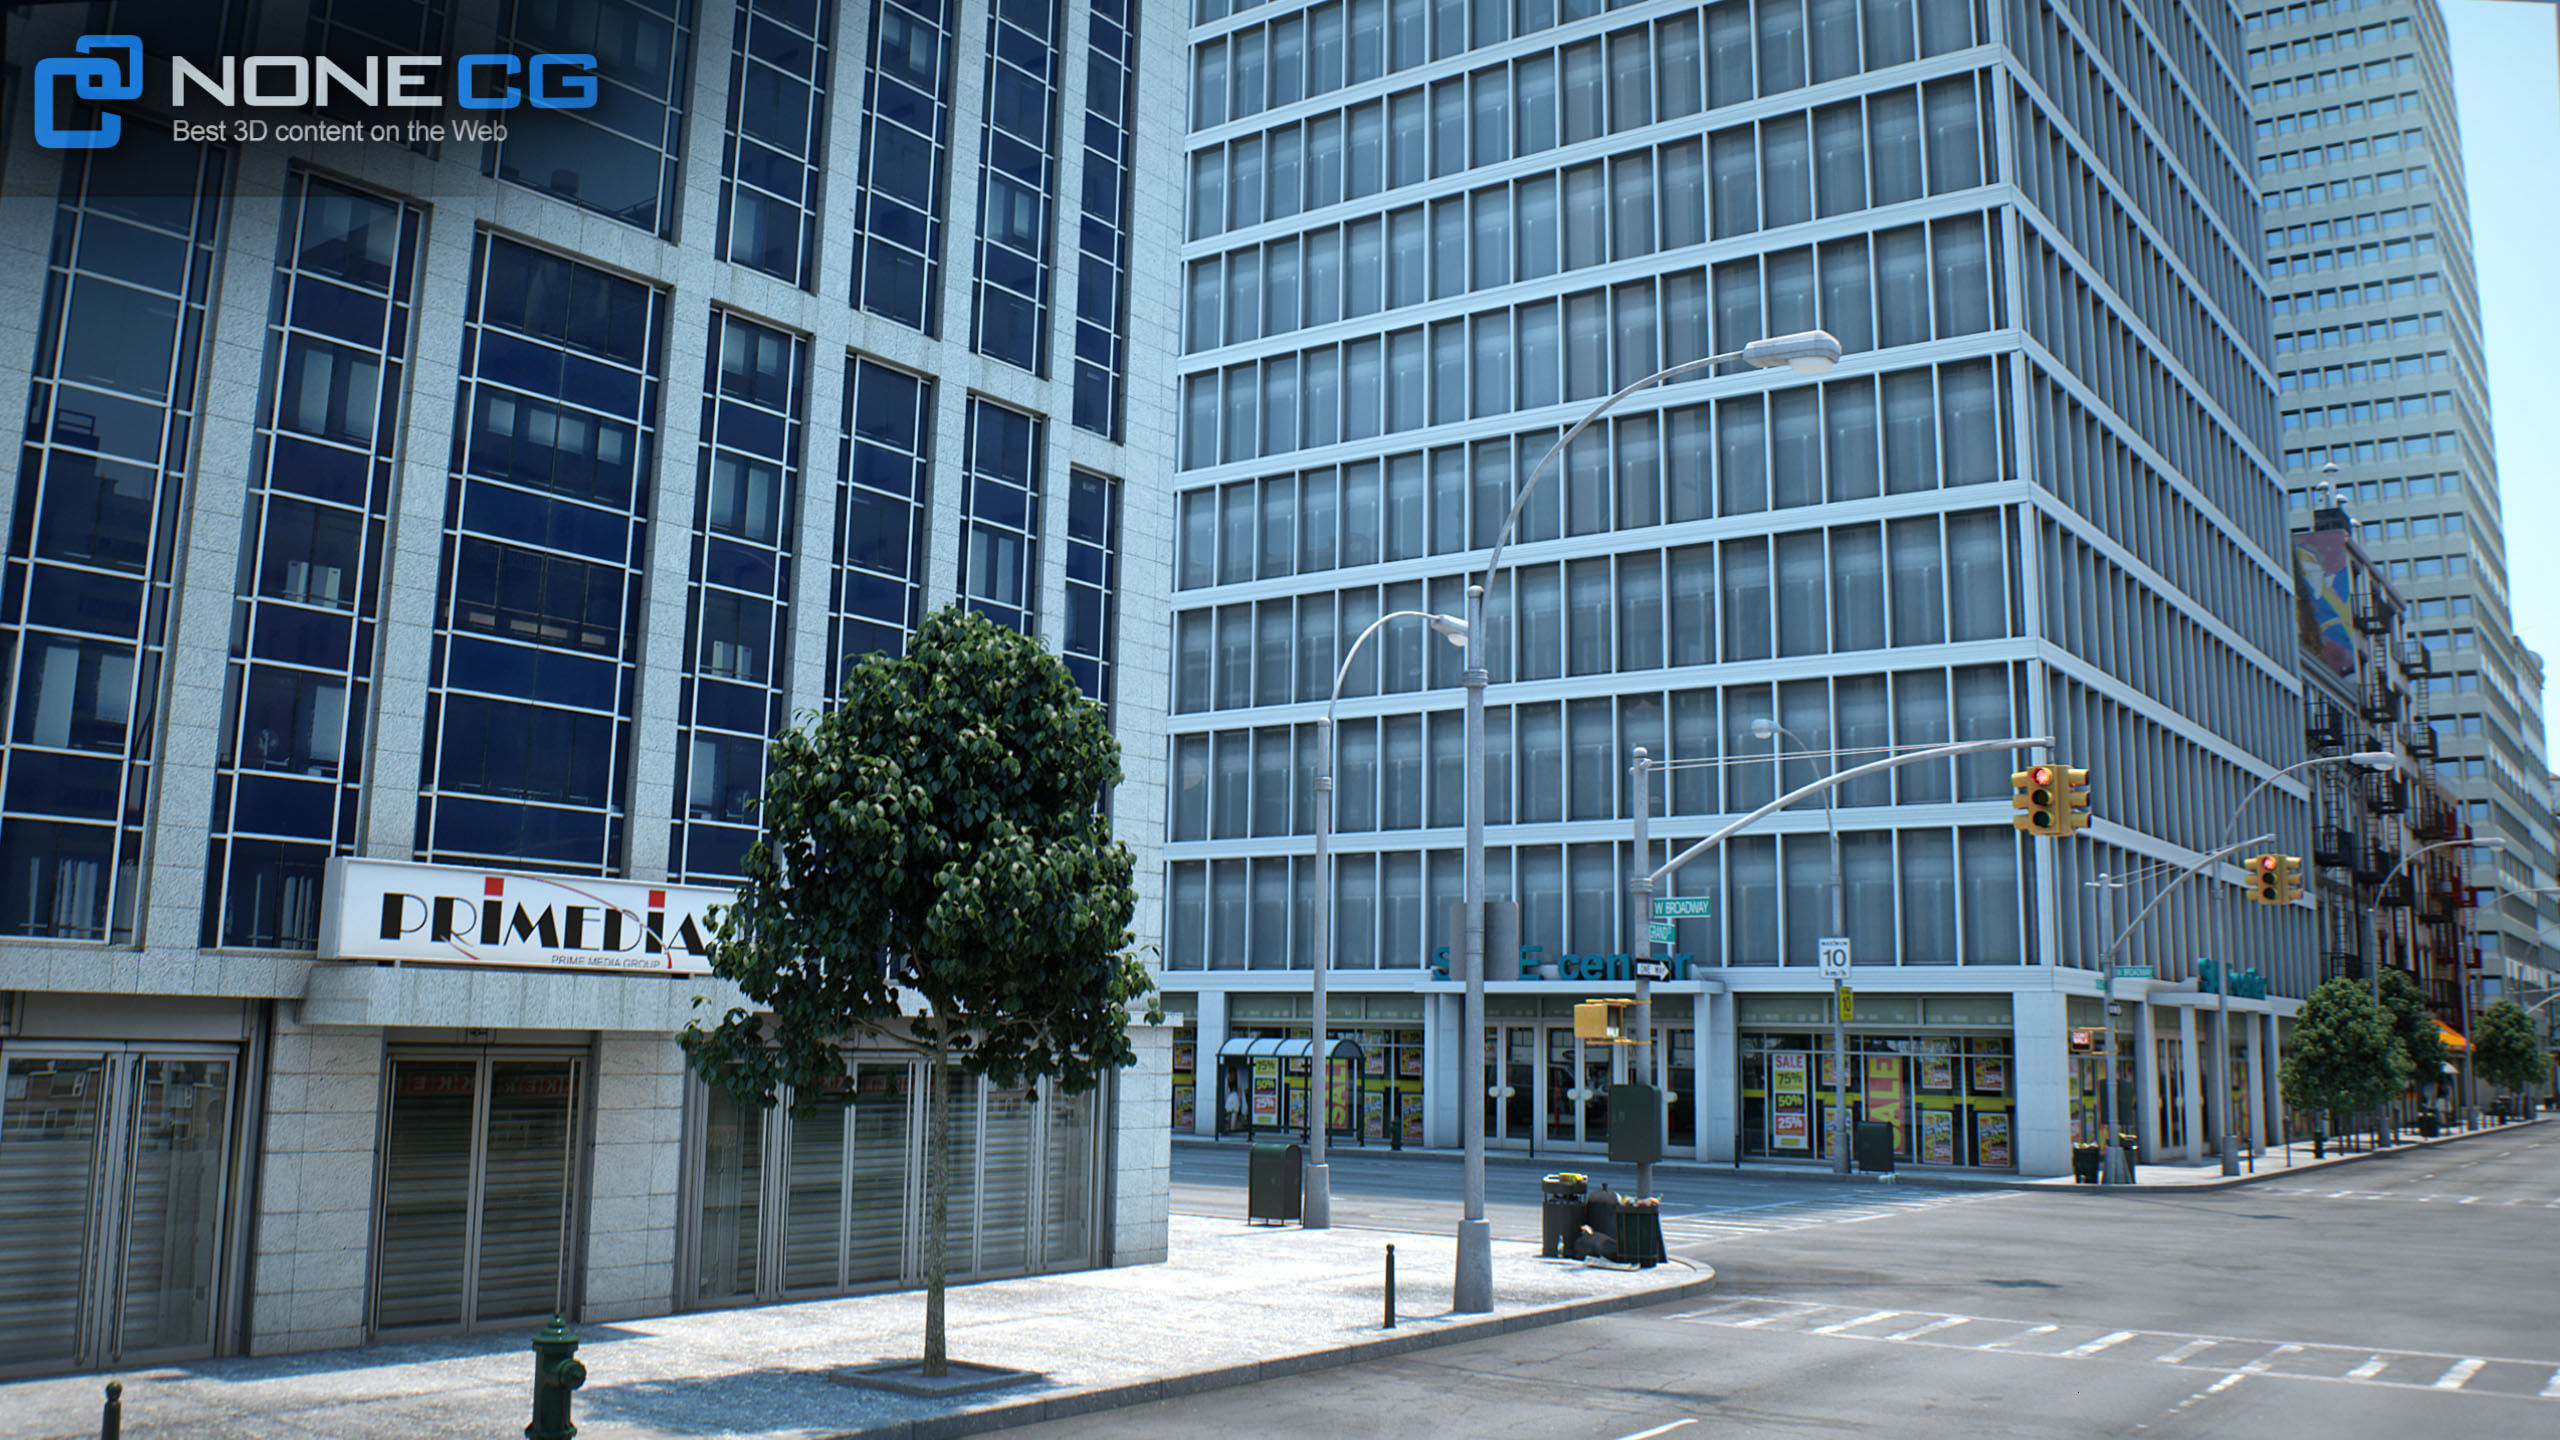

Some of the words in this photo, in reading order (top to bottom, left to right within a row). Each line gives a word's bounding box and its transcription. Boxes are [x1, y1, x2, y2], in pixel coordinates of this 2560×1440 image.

[1654, 902, 1664, 914] W
[1666, 901, 1709, 914] BROADWAY
[552, 955, 584, 967] PRIME
[587, 956, 621, 968] MEDIA
[622, 957, 660, 969] GROUP
[1823, 949, 1846, 967] 10
[1776, 1055, 1803, 1068] SALE
[1777, 1072, 1803, 1086] 75%
[1778, 1095, 1803, 1108] 50%
[1869, 1058, 1900, 1152] ALE
[1778, 1116, 1803, 1129] 25%
